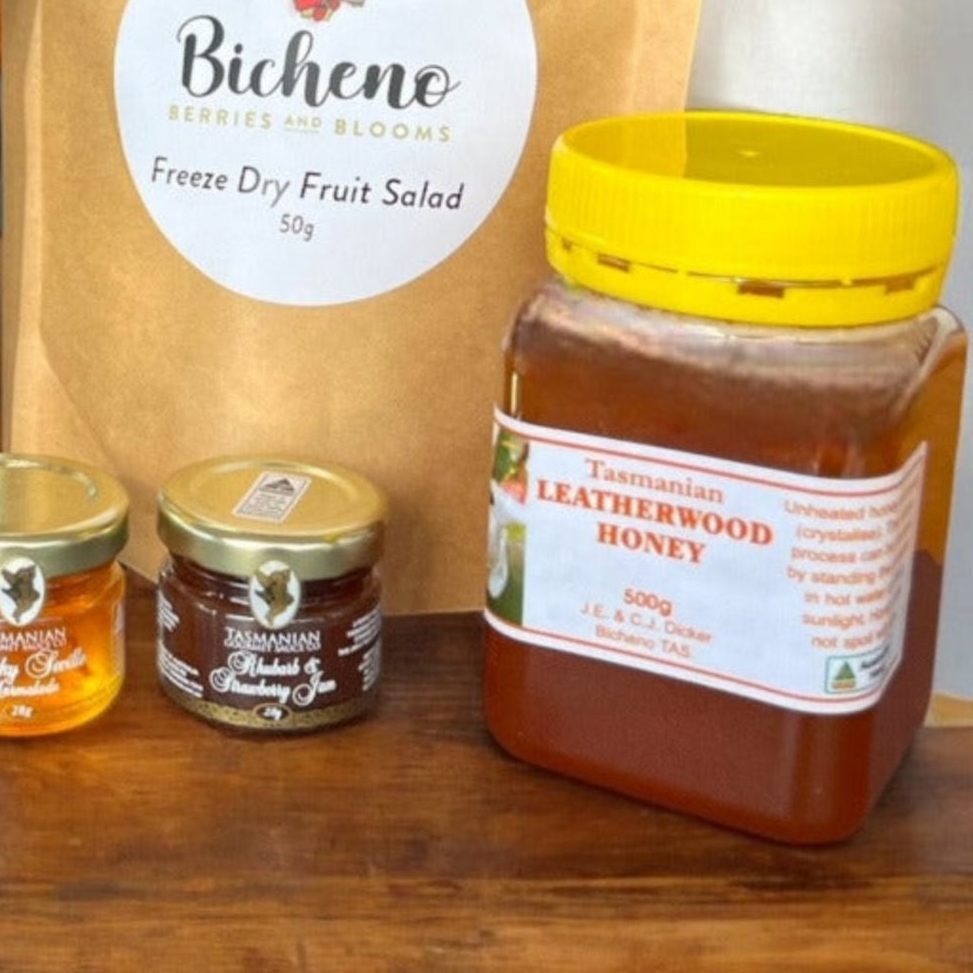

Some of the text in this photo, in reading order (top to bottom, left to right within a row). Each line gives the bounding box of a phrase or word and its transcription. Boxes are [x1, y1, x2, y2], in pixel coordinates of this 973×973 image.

[176, 14, 461, 110] Bicheno
[168, 104, 453, 144] BERRIES AND BLOOMS
[151, 156, 465, 211] Freeze Dry Fruit Salad
[279, 213, 316, 242] 50g
[585, 457, 724, 504] Tasmanian
[537, 480, 774, 546] LEATHERWOOD
[784, 499, 865, 521] Unheated
[597, 522, 707, 564] HONEY
[787, 565, 805, 583] by
[623, 587, 672, 617] 500g
[825, 592, 850, 606] hot
[225, 627, 321, 650] TASMANIAN
[595, 624, 656, 650] Bicheno
[811, 635, 838, 648] not
[228, 649, 301, 678] Rhubarb
[209, 667, 337, 706] Strawberry Jam
